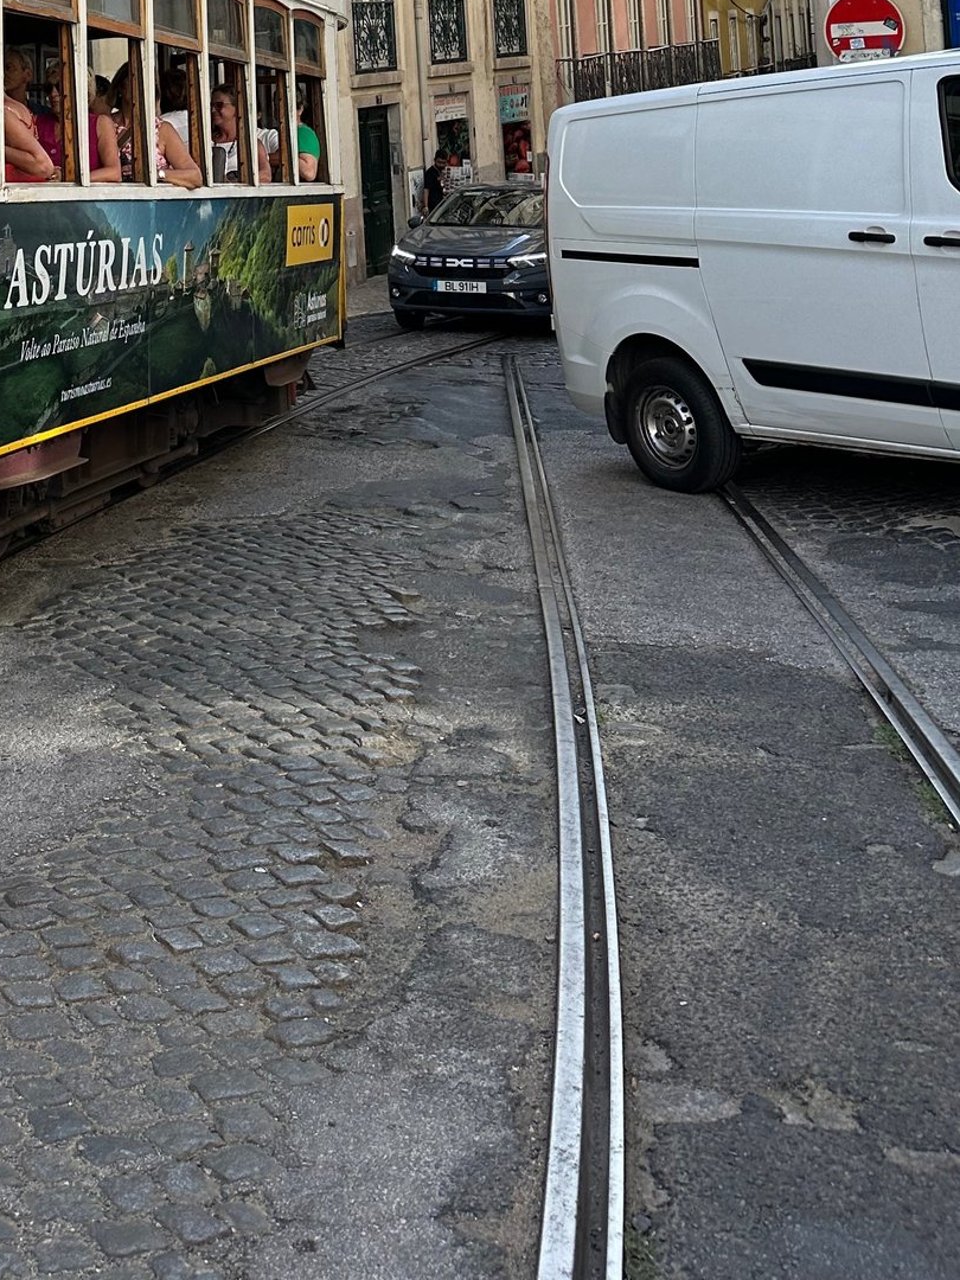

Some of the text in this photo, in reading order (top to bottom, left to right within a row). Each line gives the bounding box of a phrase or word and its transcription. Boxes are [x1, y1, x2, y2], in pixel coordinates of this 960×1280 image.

[3, 230, 164, 310] ASTÚRIAS
[19, 337, 41, 363] Volte
[41, 343, 51, 358] ao
[80, 321, 110, 348] Natural
[109, 319, 119, 340] de
[118, 314, 146, 344] Espanha
